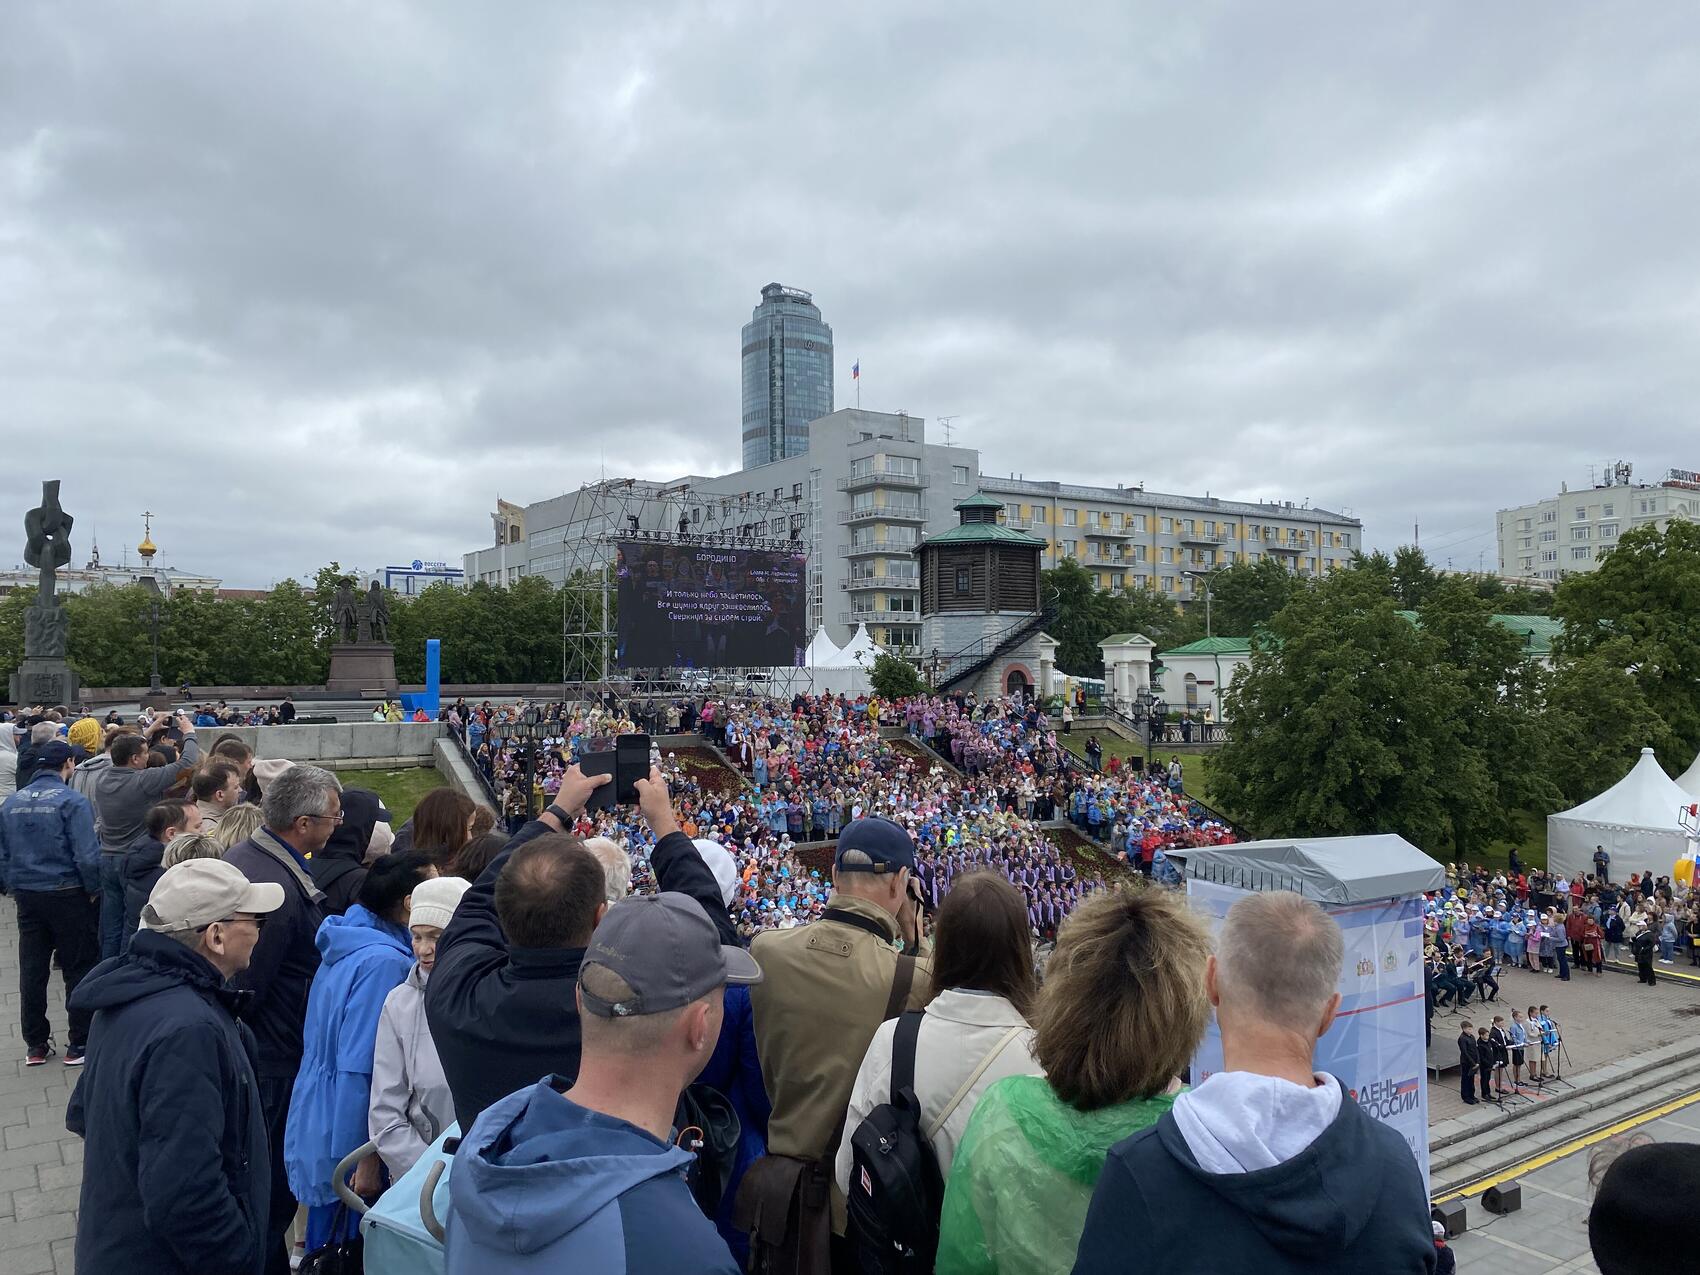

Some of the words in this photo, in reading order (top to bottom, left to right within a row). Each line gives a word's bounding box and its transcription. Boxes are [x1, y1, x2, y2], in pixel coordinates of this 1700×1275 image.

[696, 553, 737, 563] БОРОДИНО
[700, 591, 718, 599] небо
[672, 602, 698, 610] шумно
[699, 603, 720, 611] вдруг
[668, 612, 704, 621] Сверкнул
[1360, 1079, 1398, 1105] ДЕНЬ
